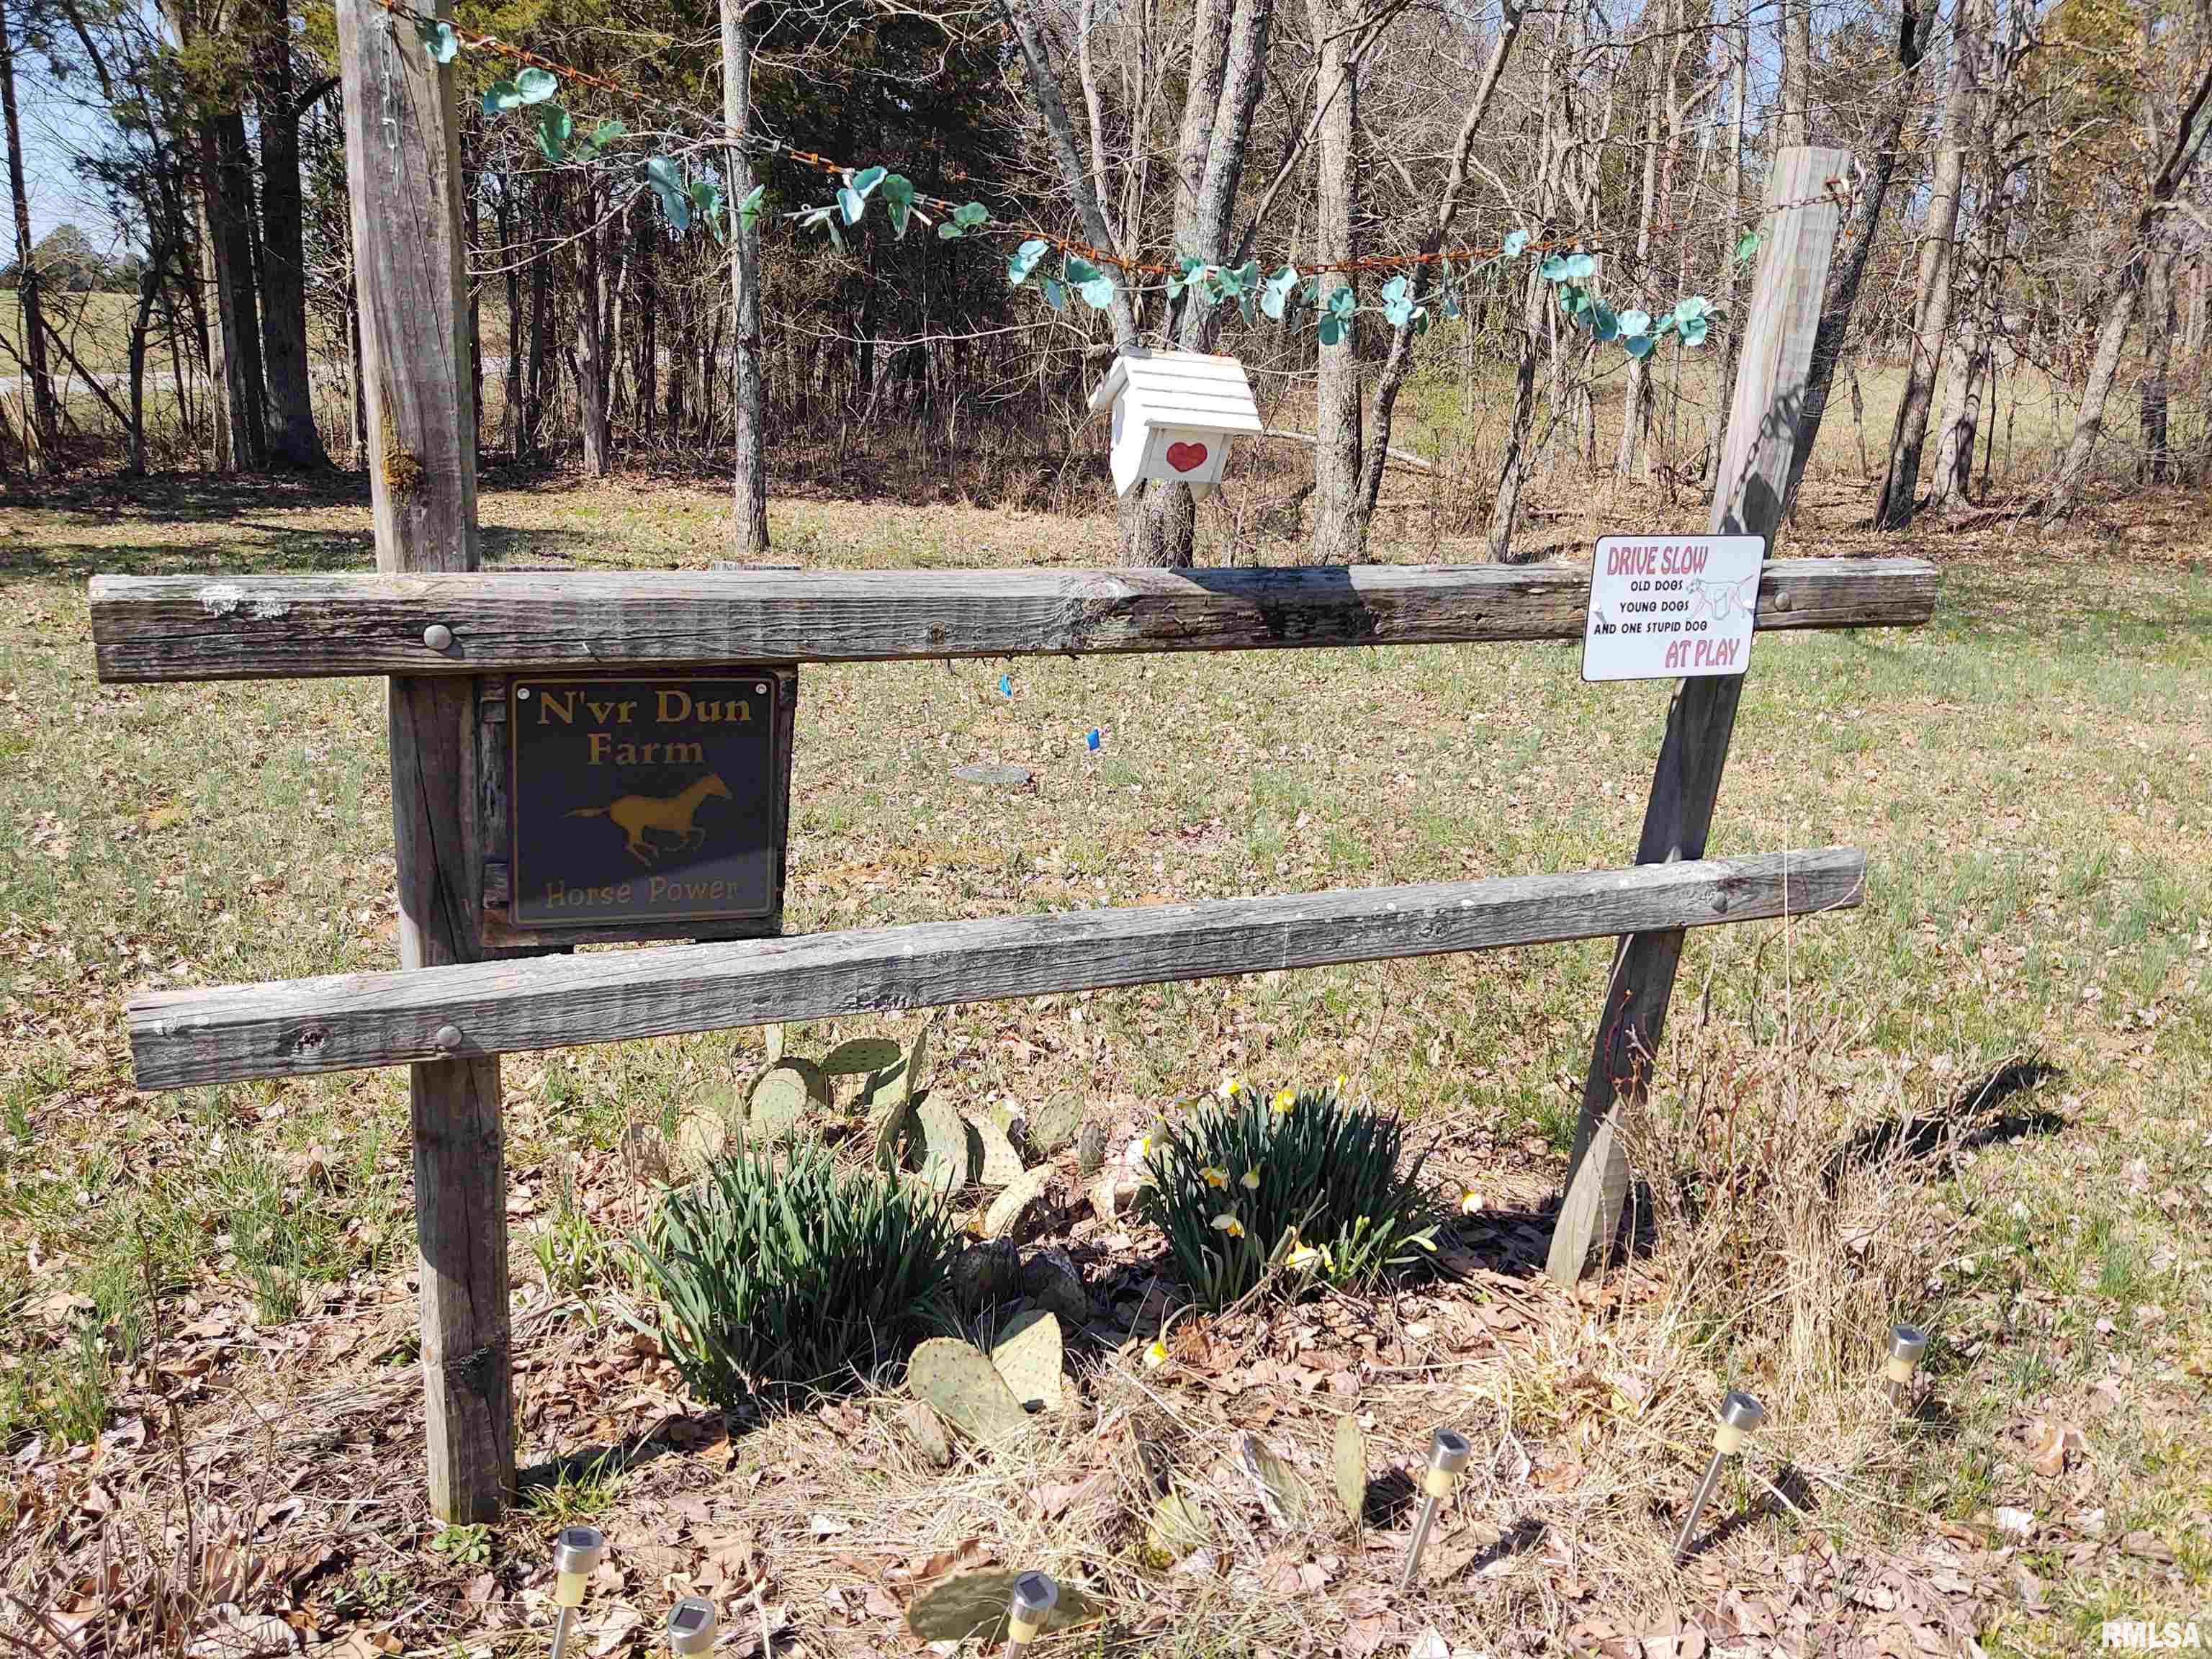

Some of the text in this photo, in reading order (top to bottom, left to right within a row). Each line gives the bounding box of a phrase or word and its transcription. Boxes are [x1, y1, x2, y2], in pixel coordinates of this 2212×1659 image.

[1607, 546, 1709, 575] DRIVE SLOW
[1631, 580, 1683, 591] OLD DOGS
[1620, 601, 1689, 613] YOUNG DOGS
[1594, 621, 1708, 634] AND ONE STUPID DOG
[1665, 639, 1740, 668] AT PLAY
[536, 690, 752, 724] N'vr Dun
[587, 732, 705, 765] Farm
[544, 876, 738, 909] Horse Power
